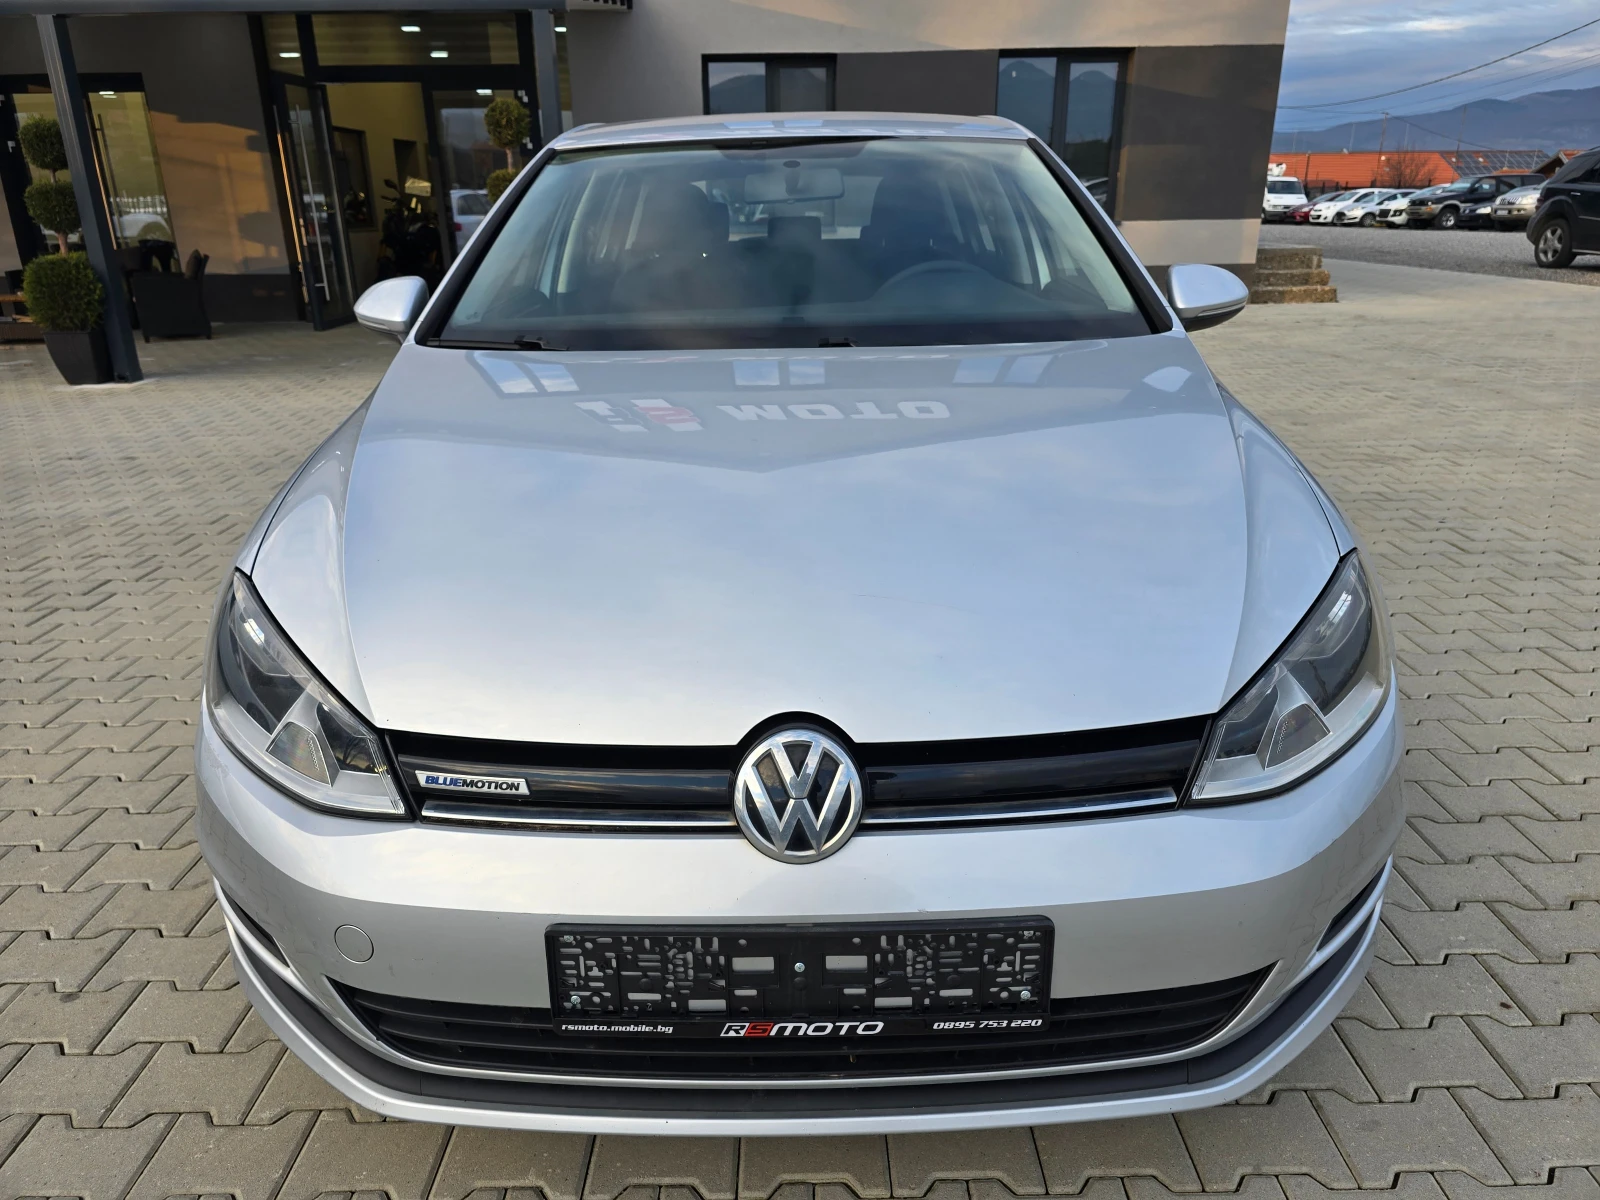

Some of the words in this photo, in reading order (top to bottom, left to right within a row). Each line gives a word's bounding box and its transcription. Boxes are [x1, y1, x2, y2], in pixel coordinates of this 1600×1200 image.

[424, 775, 521, 791] BLUEMOTION
[561, 1024, 674, 1034] rsmoto.mobile.bg
[932, 1021, 976, 1030] 0895
[978, 1020, 1009, 1028] 753
[1010, 1019, 1043, 1027] 220
